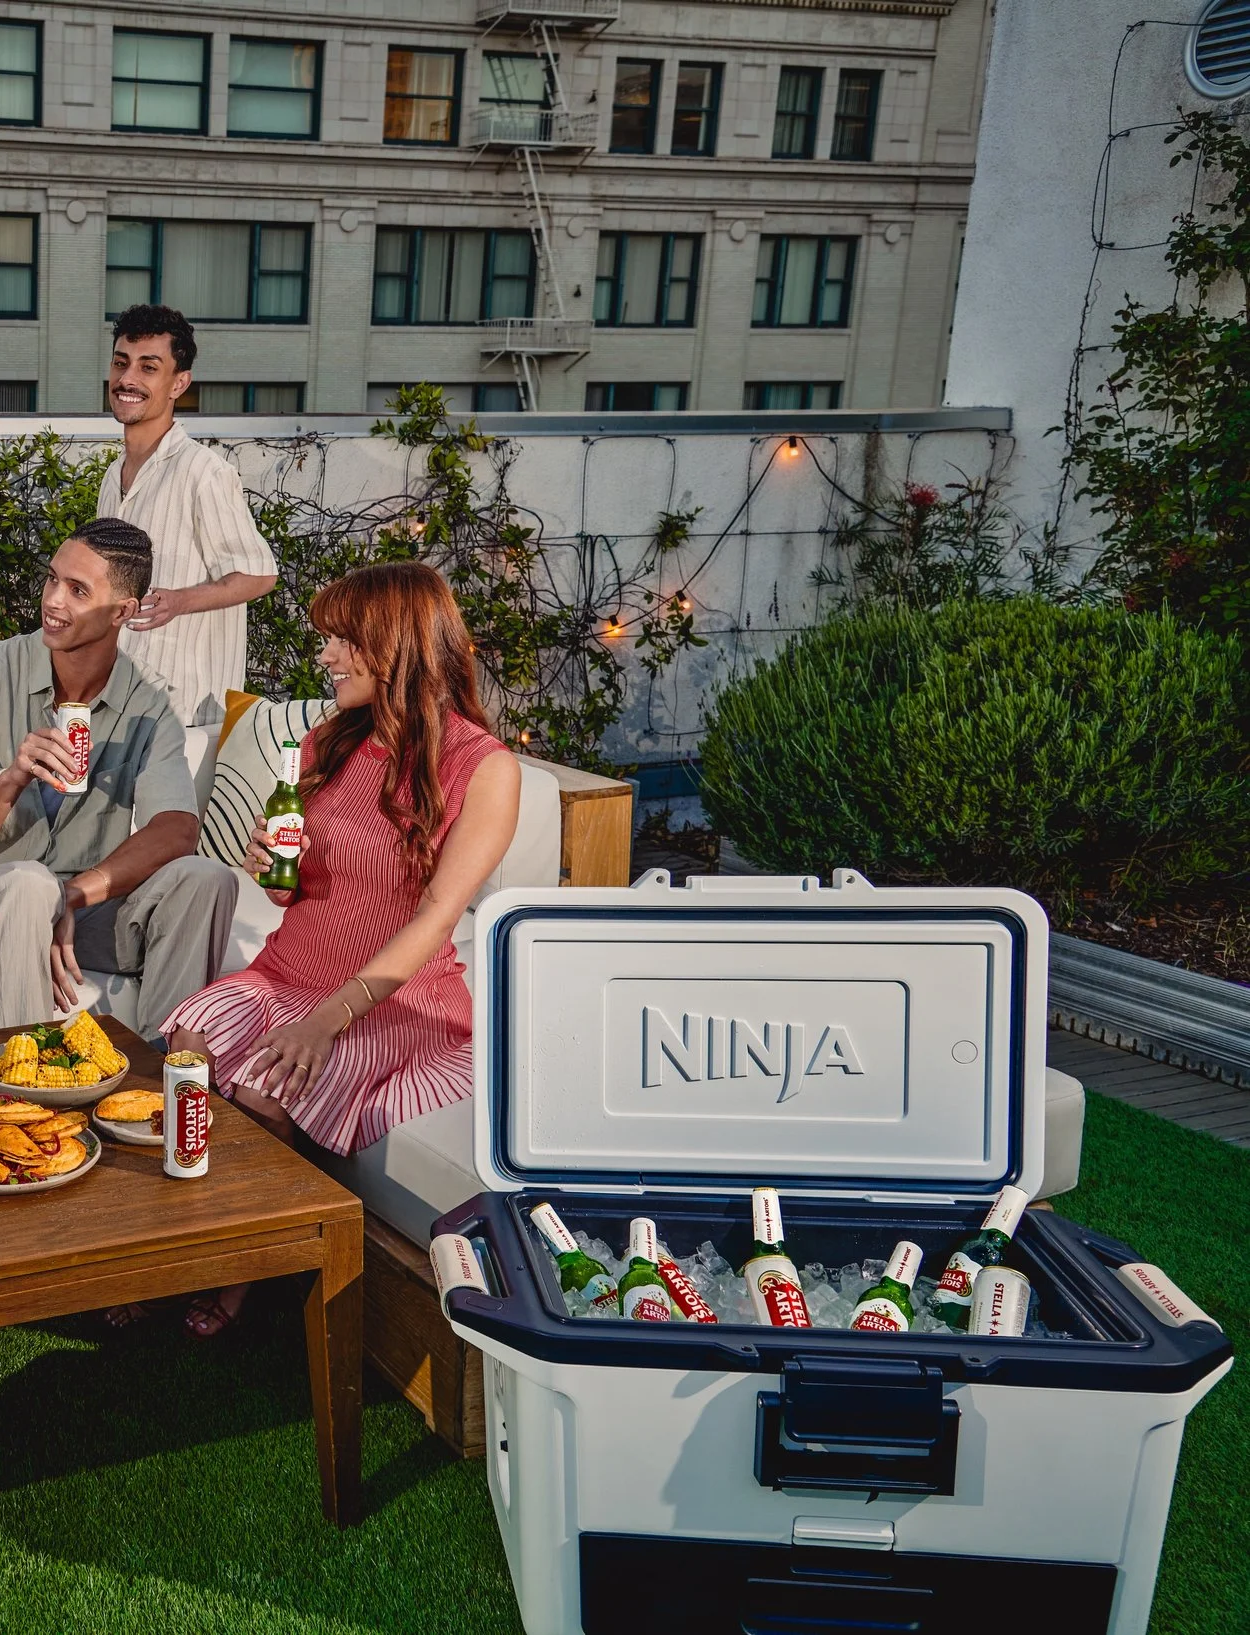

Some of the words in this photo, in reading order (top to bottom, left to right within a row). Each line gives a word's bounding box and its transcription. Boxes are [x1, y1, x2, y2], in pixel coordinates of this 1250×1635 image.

[82, 731, 90, 771] STELLA
[642, 1005, 865, 1104] NINJA
[185, 1098, 197, 1152] ARTOIS
[198, 1095, 206, 1149] STELLA
[547, 1212, 560, 1228] ARTOIS
[561, 1234, 574, 1250] STELLA
[454, 1239, 466, 1257] STELLA
[461, 1261, 473, 1280] ARTOIS
[895, 1266, 904, 1280] STELLA
[902, 1248, 912, 1262] ARTOIS
[940, 1278, 962, 1289] RTOIS
[942, 1271, 963, 1282] TELLA
[1132, 1268, 1159, 1290] ARTOIS
[663, 1269, 707, 1319] ARTOIS
[773, 1289, 795, 1327] ART
[788, 1289, 808, 1328] STEL
[991, 1282, 1004, 1317] STELLA
[1159, 1294, 1184, 1319] STELLA
[642, 1309, 669, 1322] ARTO
[859, 1320, 891, 1331] ARTO
[862, 1314, 897, 1331] STELLA
